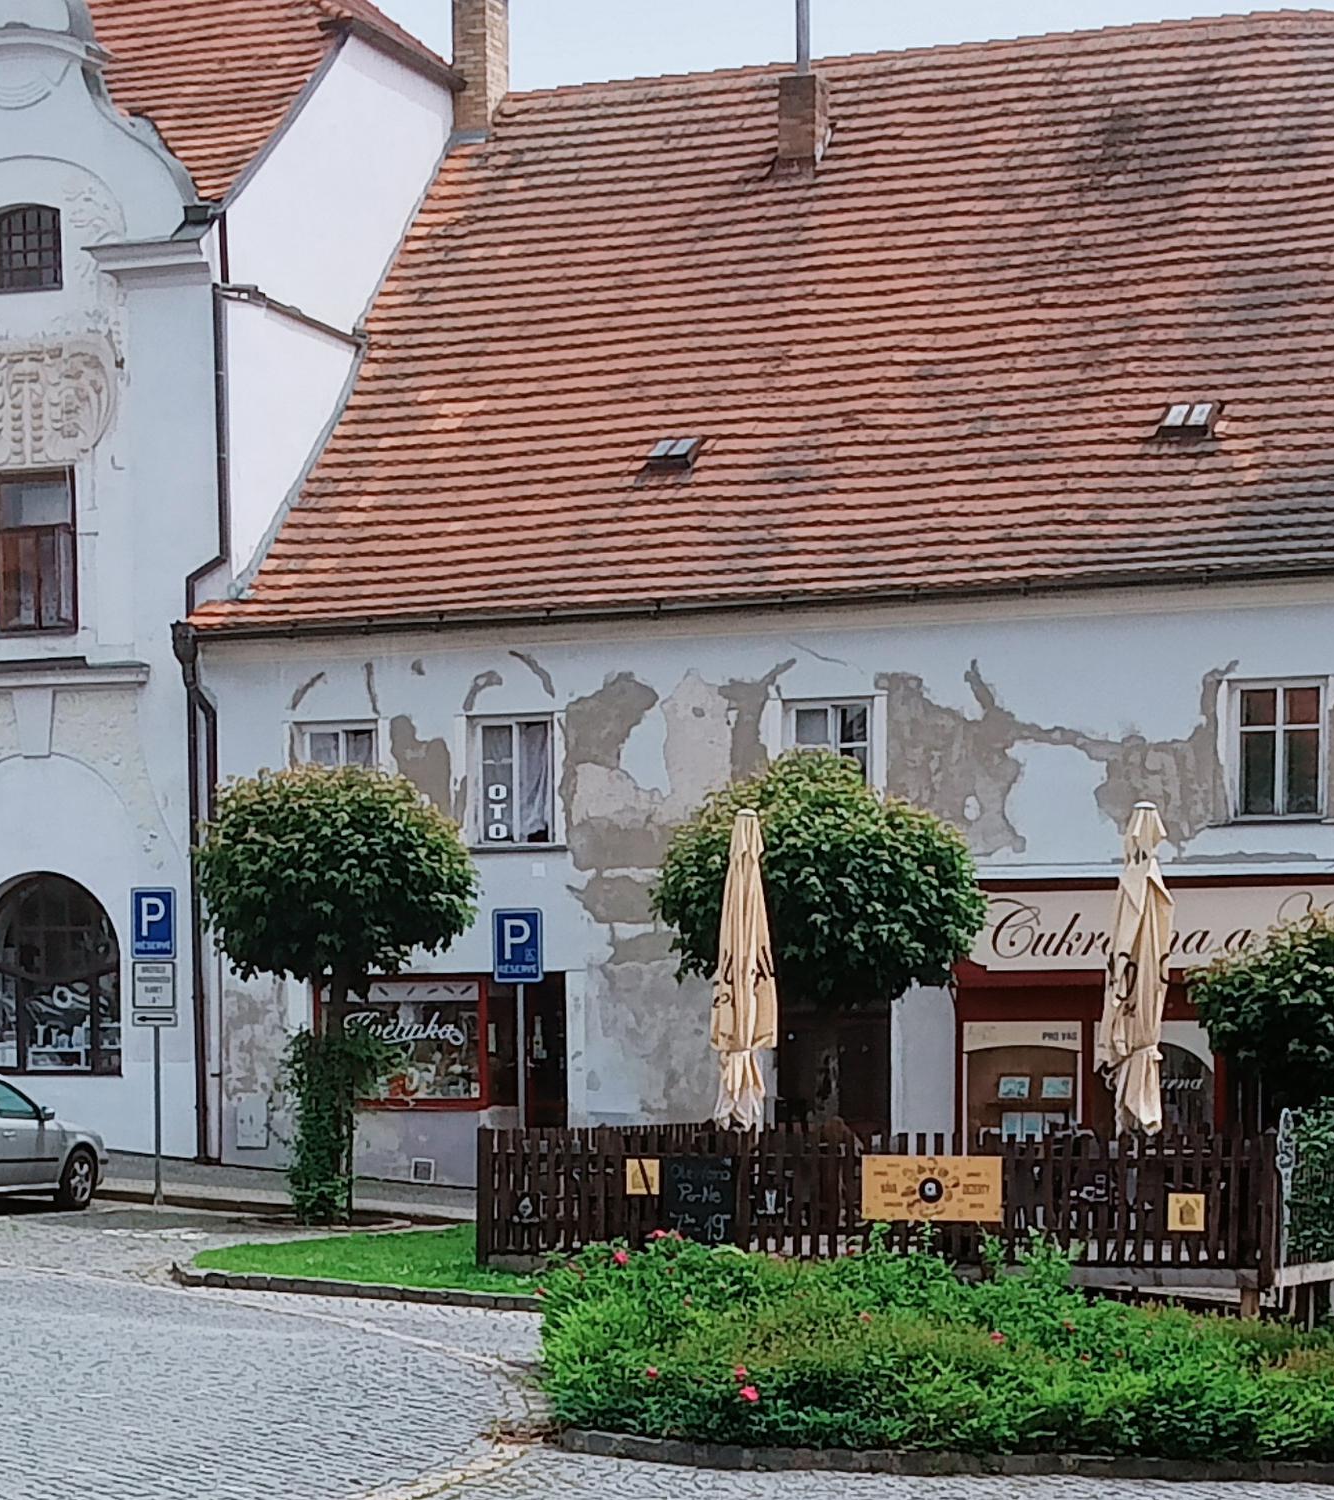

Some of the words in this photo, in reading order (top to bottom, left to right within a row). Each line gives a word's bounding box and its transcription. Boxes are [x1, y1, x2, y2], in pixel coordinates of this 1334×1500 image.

[141, 897, 166, 937] P
[980, 897, 1214, 959] Cukra
[503, 918, 531, 960] P
